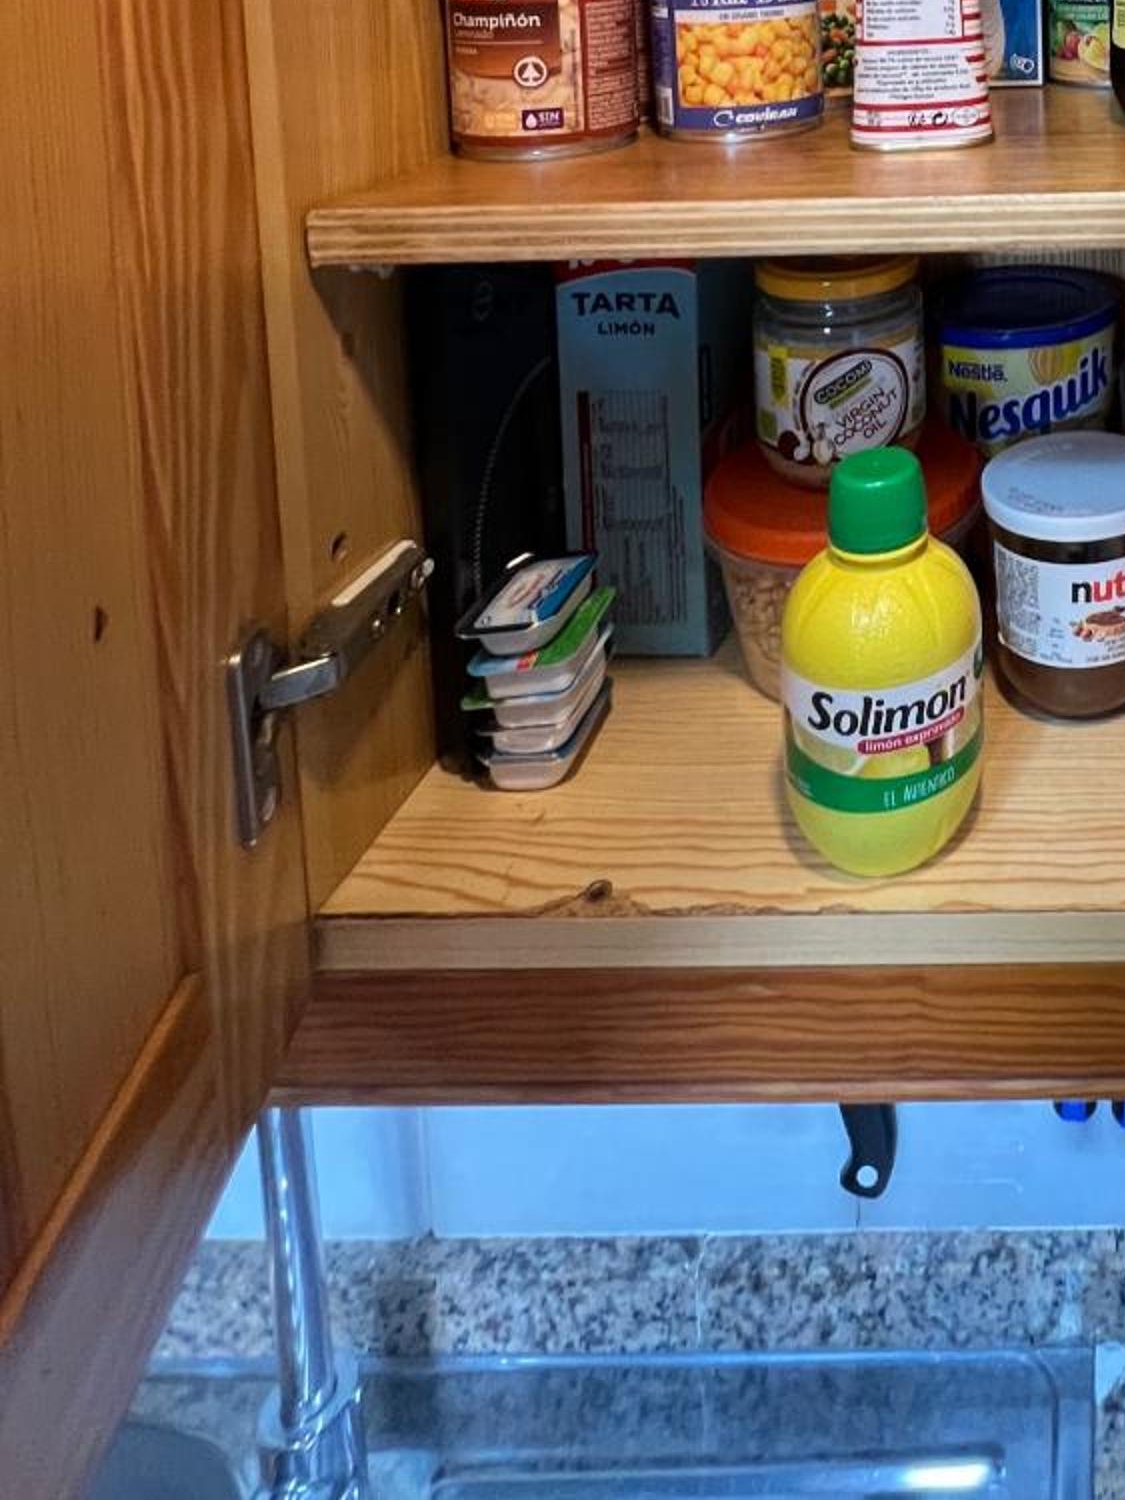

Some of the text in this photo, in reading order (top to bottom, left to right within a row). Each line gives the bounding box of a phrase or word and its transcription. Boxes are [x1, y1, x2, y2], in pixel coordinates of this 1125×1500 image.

[452, 11, 542, 31] Champiñón
[571, 292, 681, 320] TARTA
[597, 320, 656, 336] LIMÓN
[835, 386, 887, 428] VIRGIN
[951, 347, 1109, 442] Nesquik
[833, 389, 898, 446] COCONUT
[863, 418, 888, 440] OIL
[807, 675, 967, 737] Solimon
